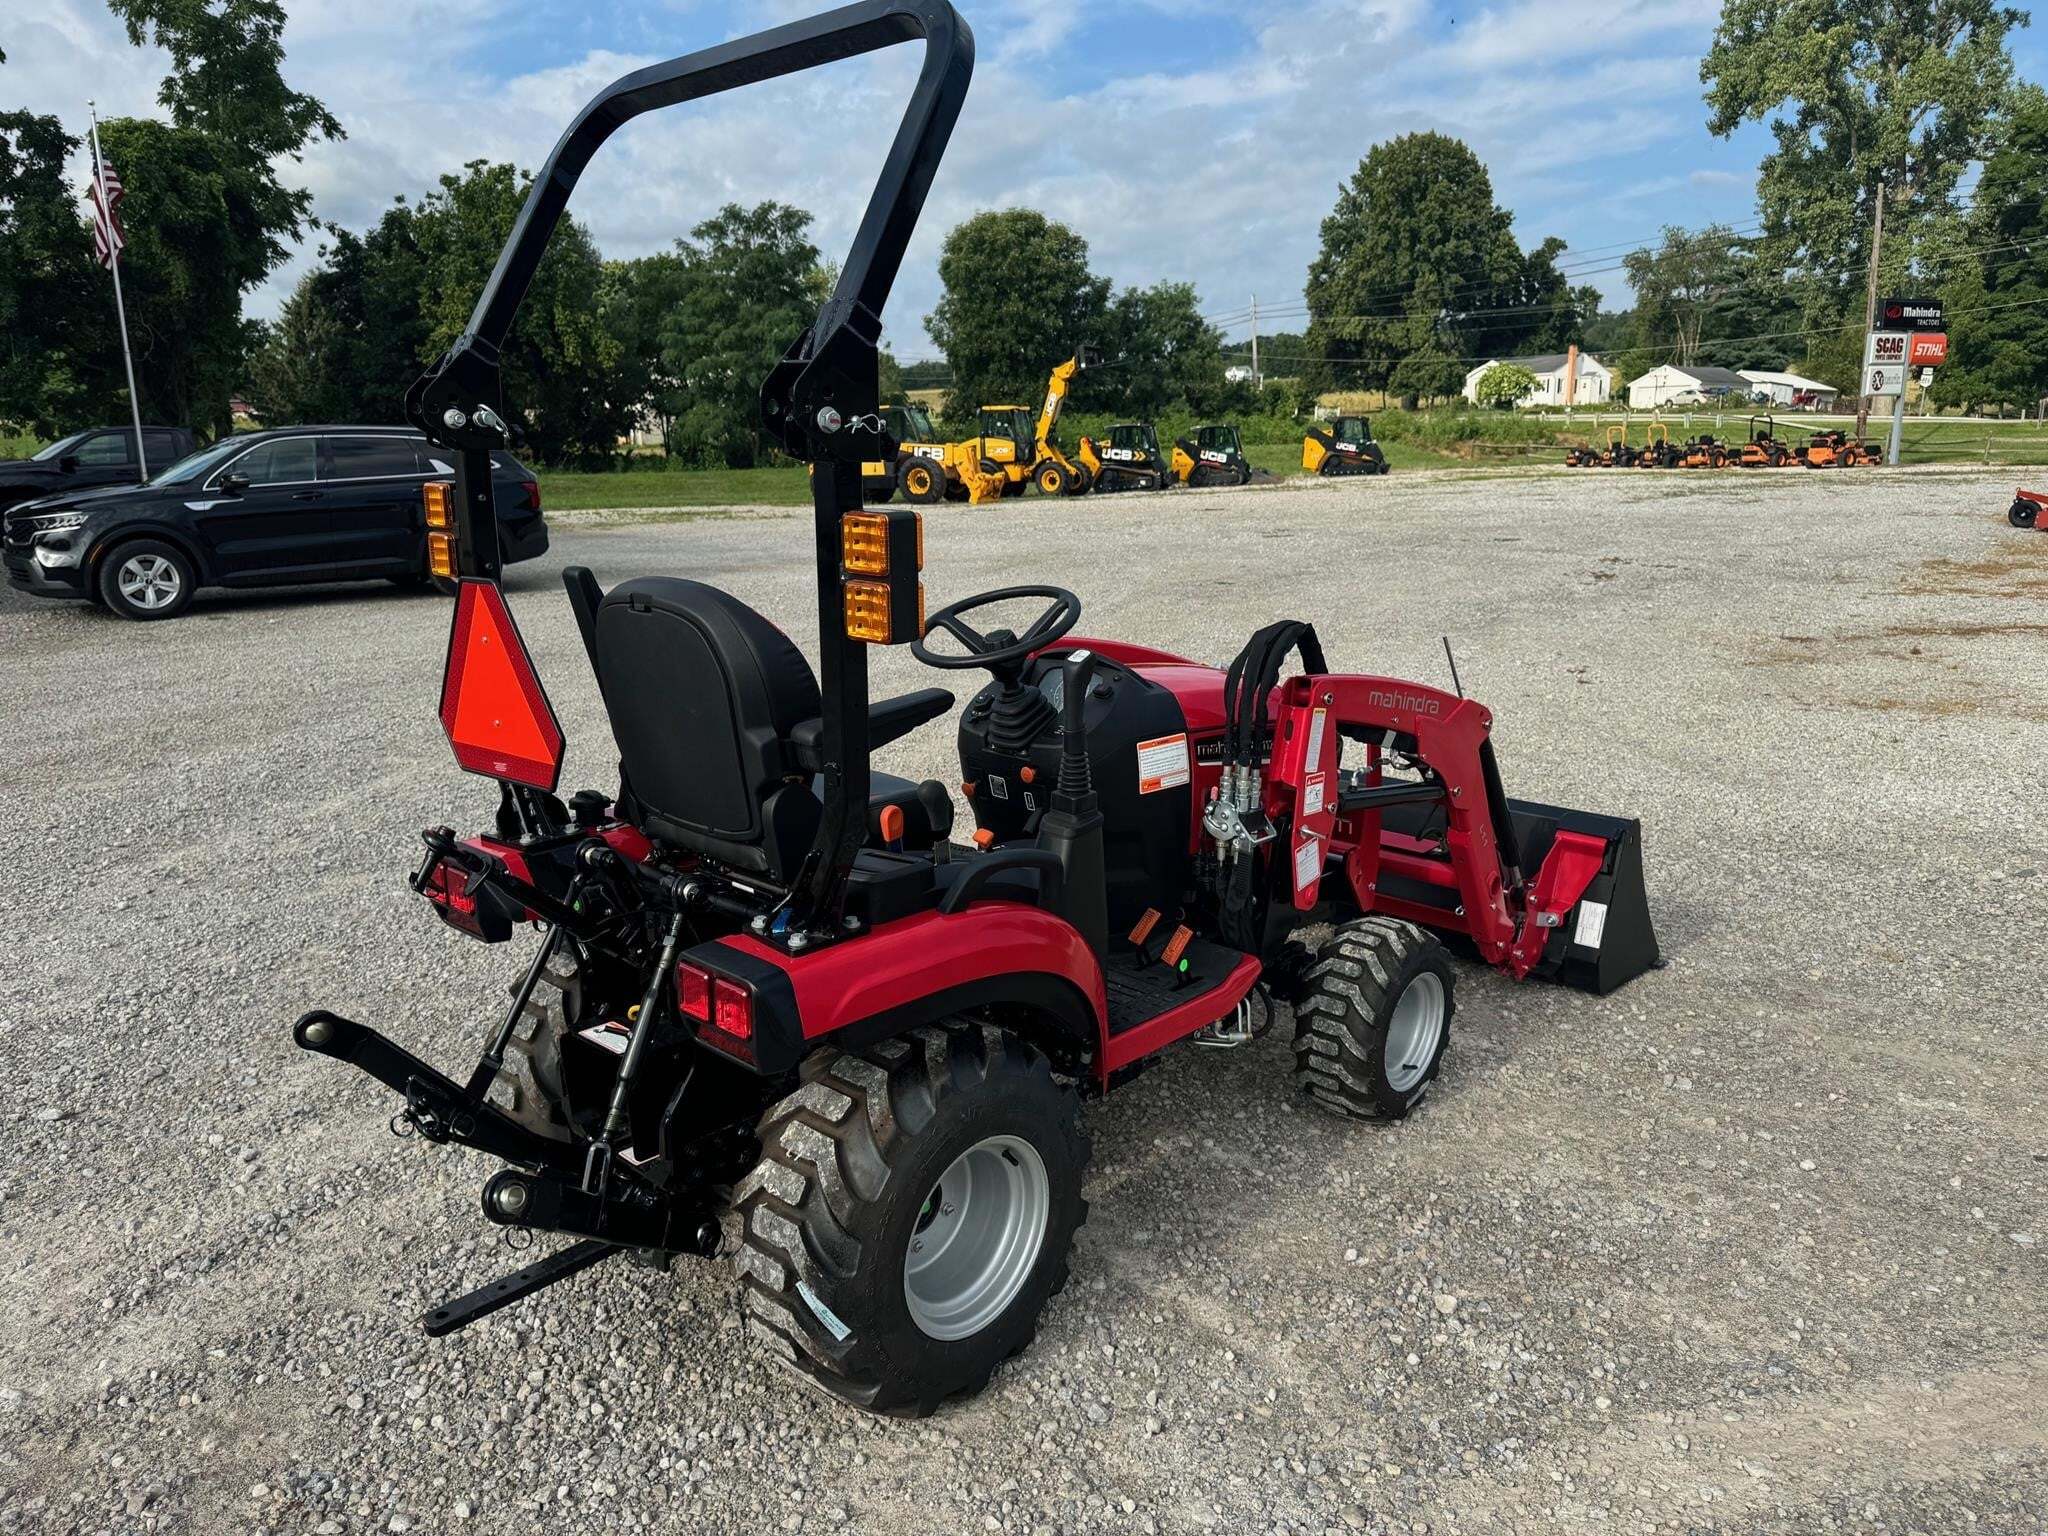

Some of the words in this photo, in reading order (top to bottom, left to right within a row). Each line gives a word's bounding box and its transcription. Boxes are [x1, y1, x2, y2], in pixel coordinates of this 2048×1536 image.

[1903, 307, 1941, 317] Mahindra
[1876, 338, 1904, 354] SCAG
[1915, 343, 1944, 356] STIHL
[1335, 441, 1357, 452] JCB
[1101, 447, 1132, 461] JCB
[1199, 449, 1228, 463] JCB
[1368, 689, 1440, 714] mahindra
